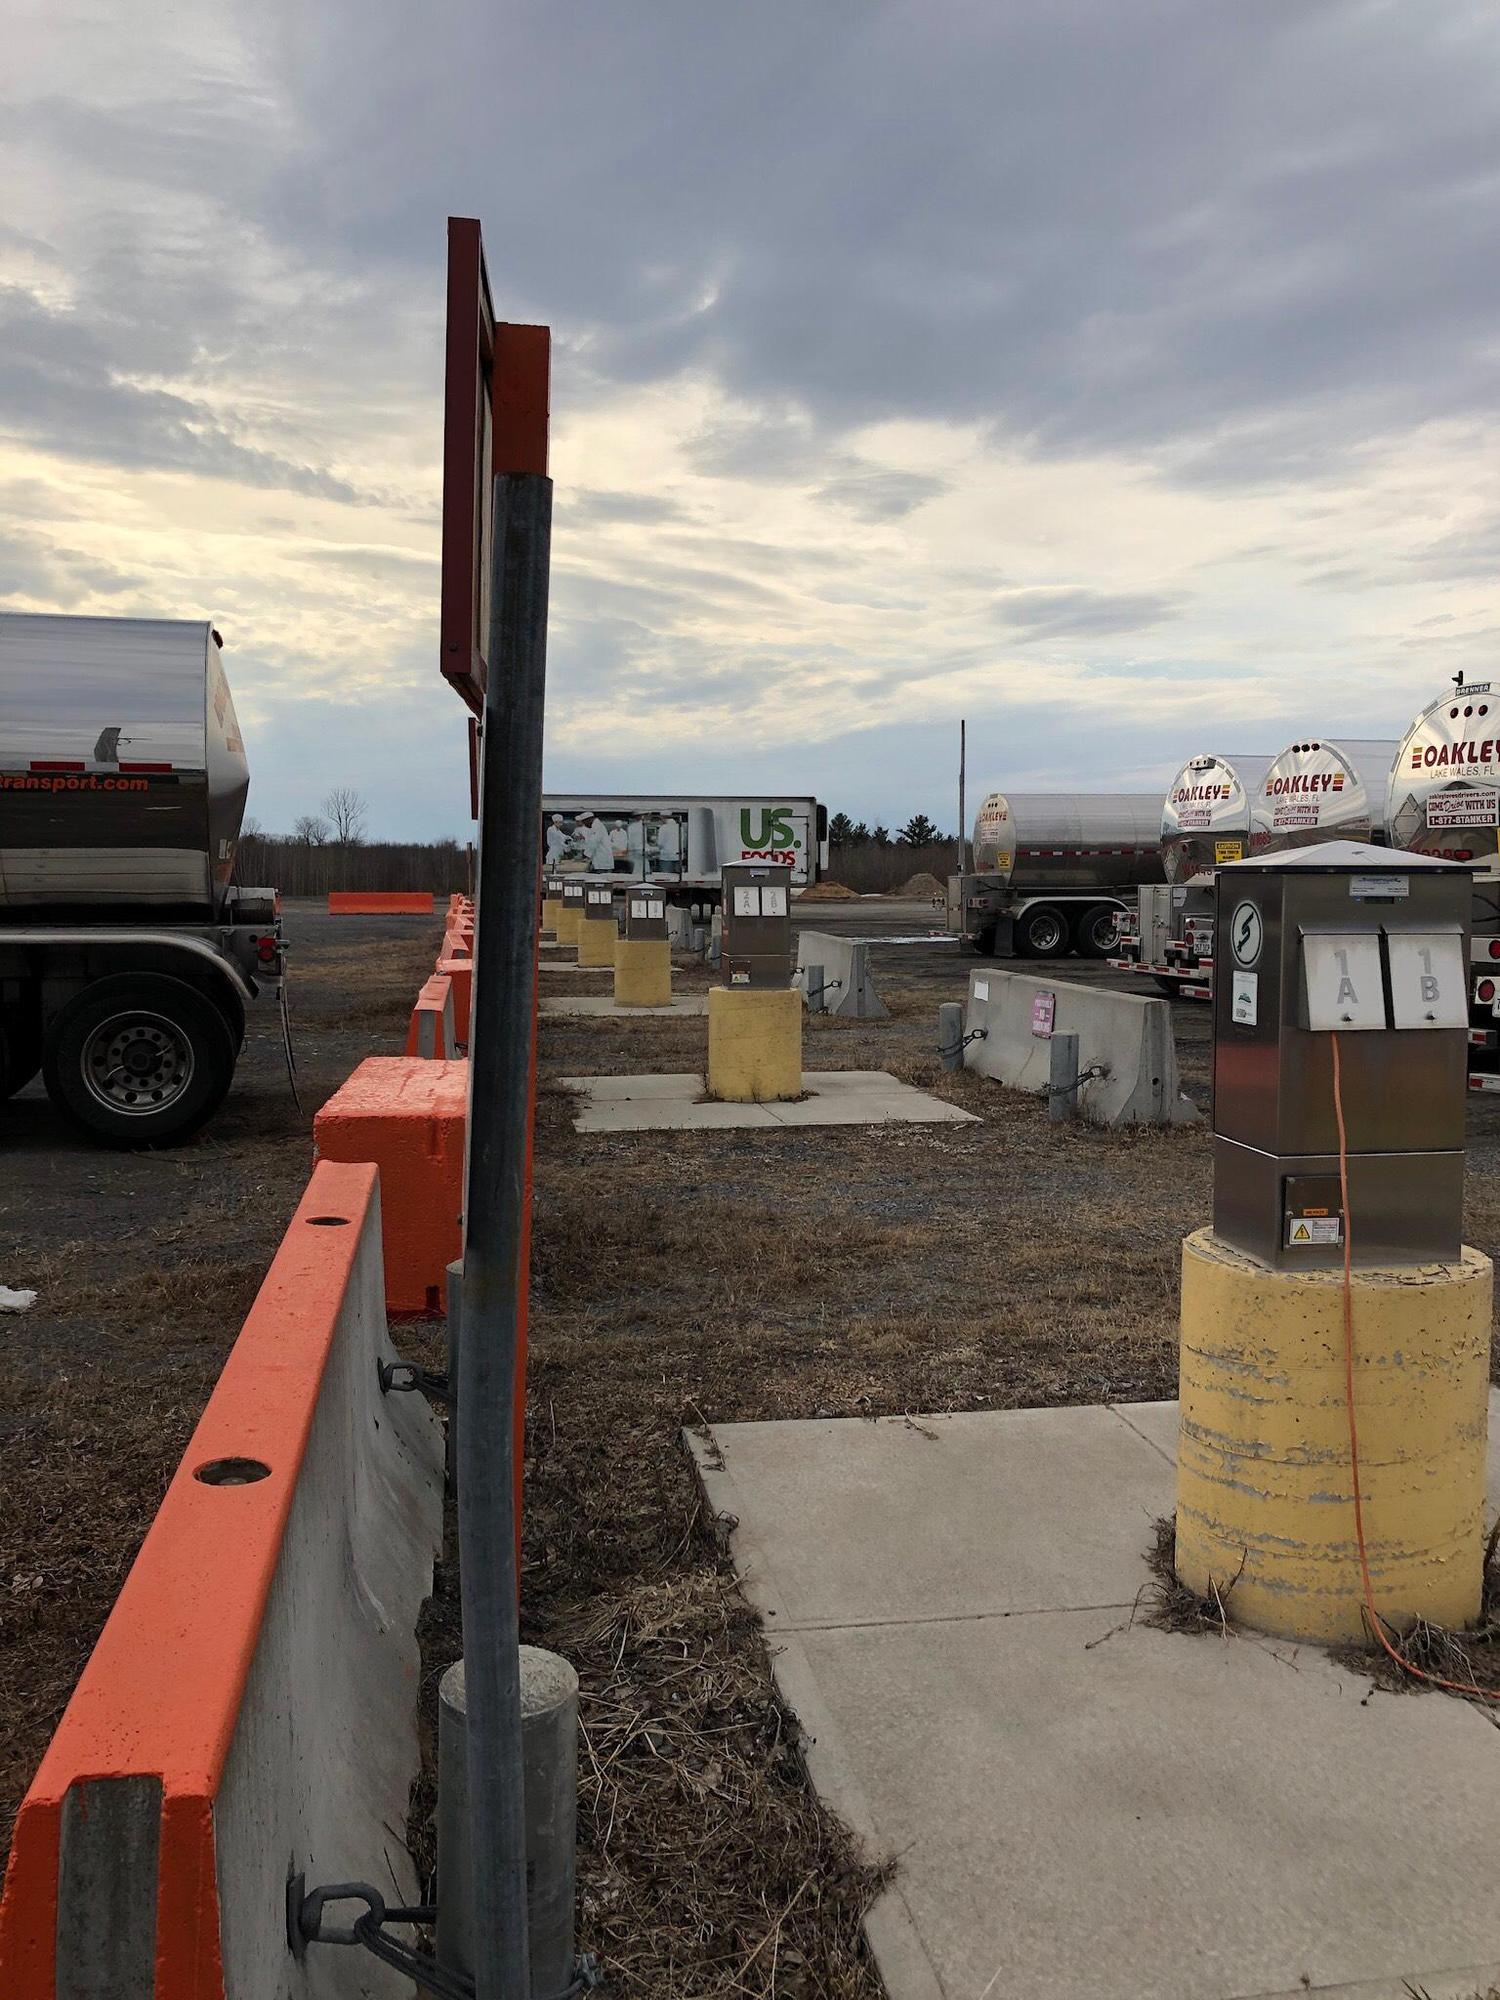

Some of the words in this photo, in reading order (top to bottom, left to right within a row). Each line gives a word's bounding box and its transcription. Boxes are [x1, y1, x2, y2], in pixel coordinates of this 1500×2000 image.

[1456, 684, 1489, 696] BRENNER
[1430, 768, 1448, 779] LAKE
[1449, 766, 1480, 777] WALES,
[1483, 765, 1495, 775] FL
[1273, 773, 1332, 795] OAKLEY
[1178, 784, 1221, 802] OAKLEY
[1465, 800, 1485, 810] WITH
[1486, 799, 1496, 809] US
[1430, 814, 1494, 825] 1-877-8TANKER
[743, 891, 750, 900] 2
[743, 900, 751, 908] A
[1334, 948, 1349, 976] 1
[1418, 947, 1432, 974] 1
[1337, 977, 1359, 1004] A
[1420, 975, 1440, 1002] B
